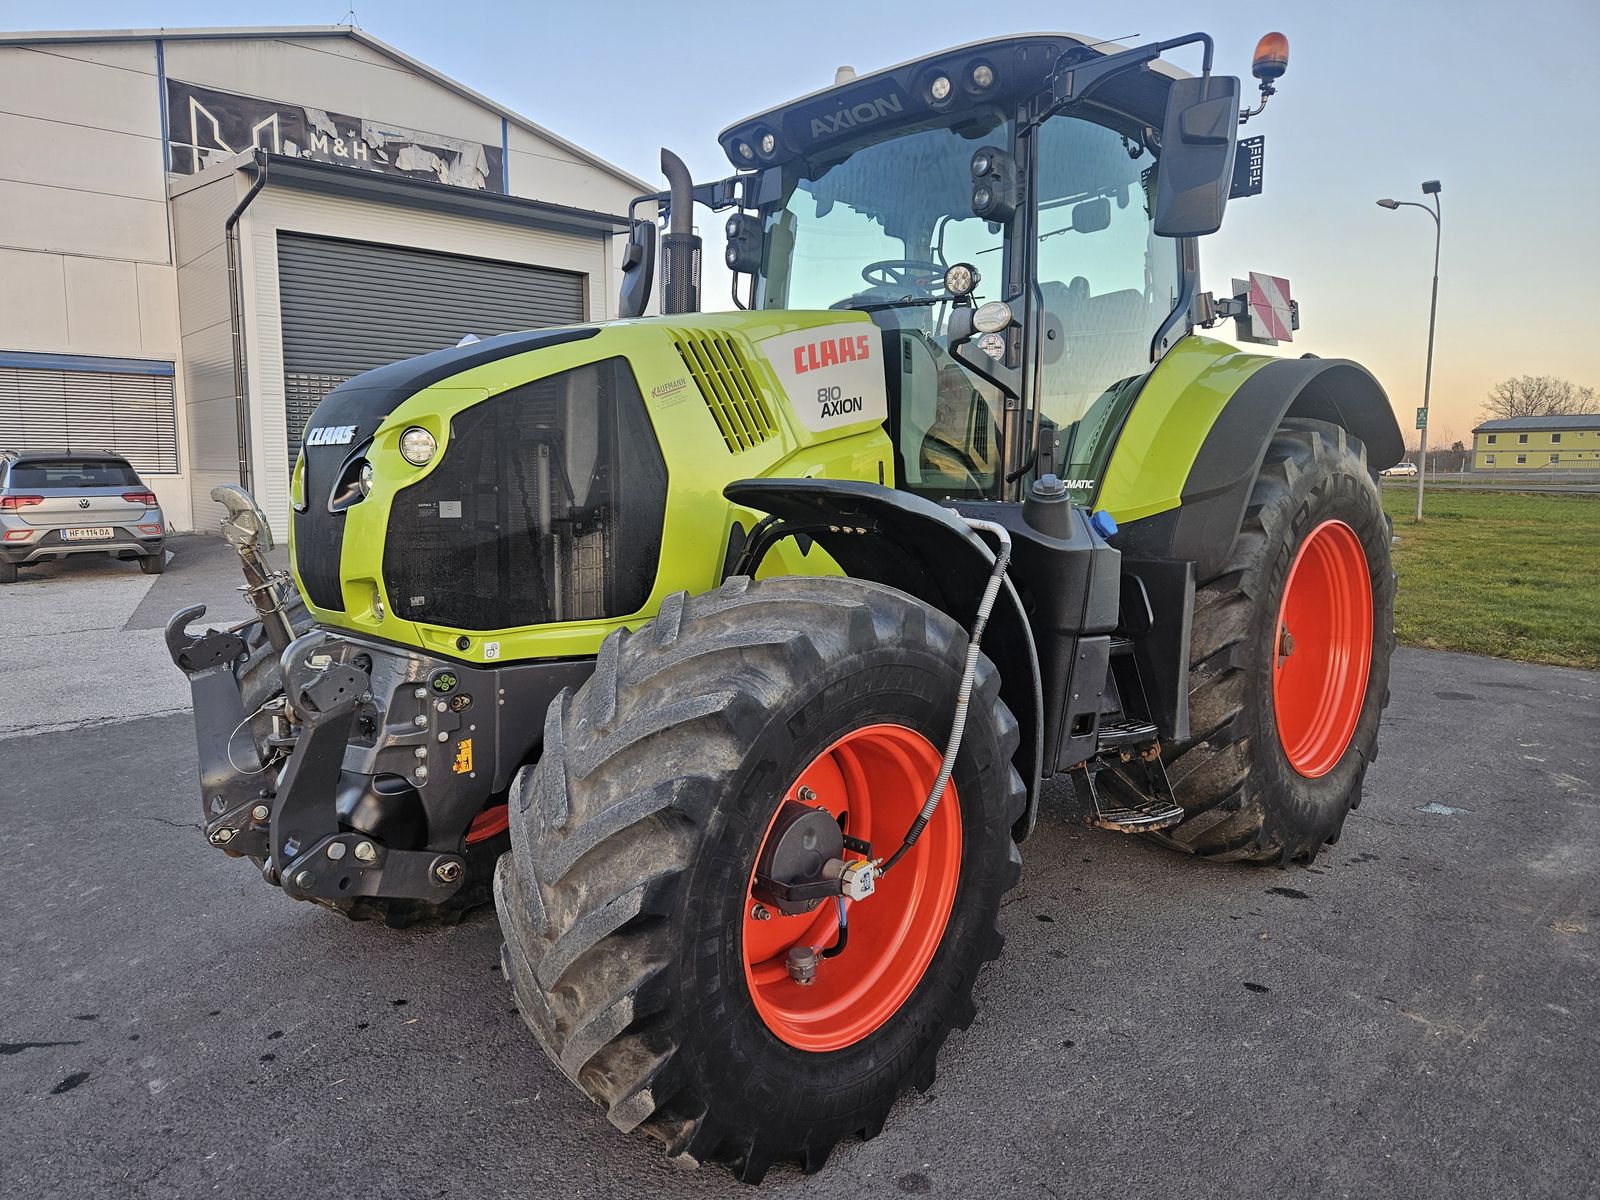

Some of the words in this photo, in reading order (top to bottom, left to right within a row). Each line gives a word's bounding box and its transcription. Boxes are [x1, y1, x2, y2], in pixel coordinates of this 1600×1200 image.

[810, 93, 904, 138] AXION
[793, 335, 870, 375] CLAAS
[651, 377, 687, 398] KAUFMANN
[817, 386, 842, 403] 810
[820, 396, 862, 418] AXION
[306, 425, 358, 446] CLAAS
